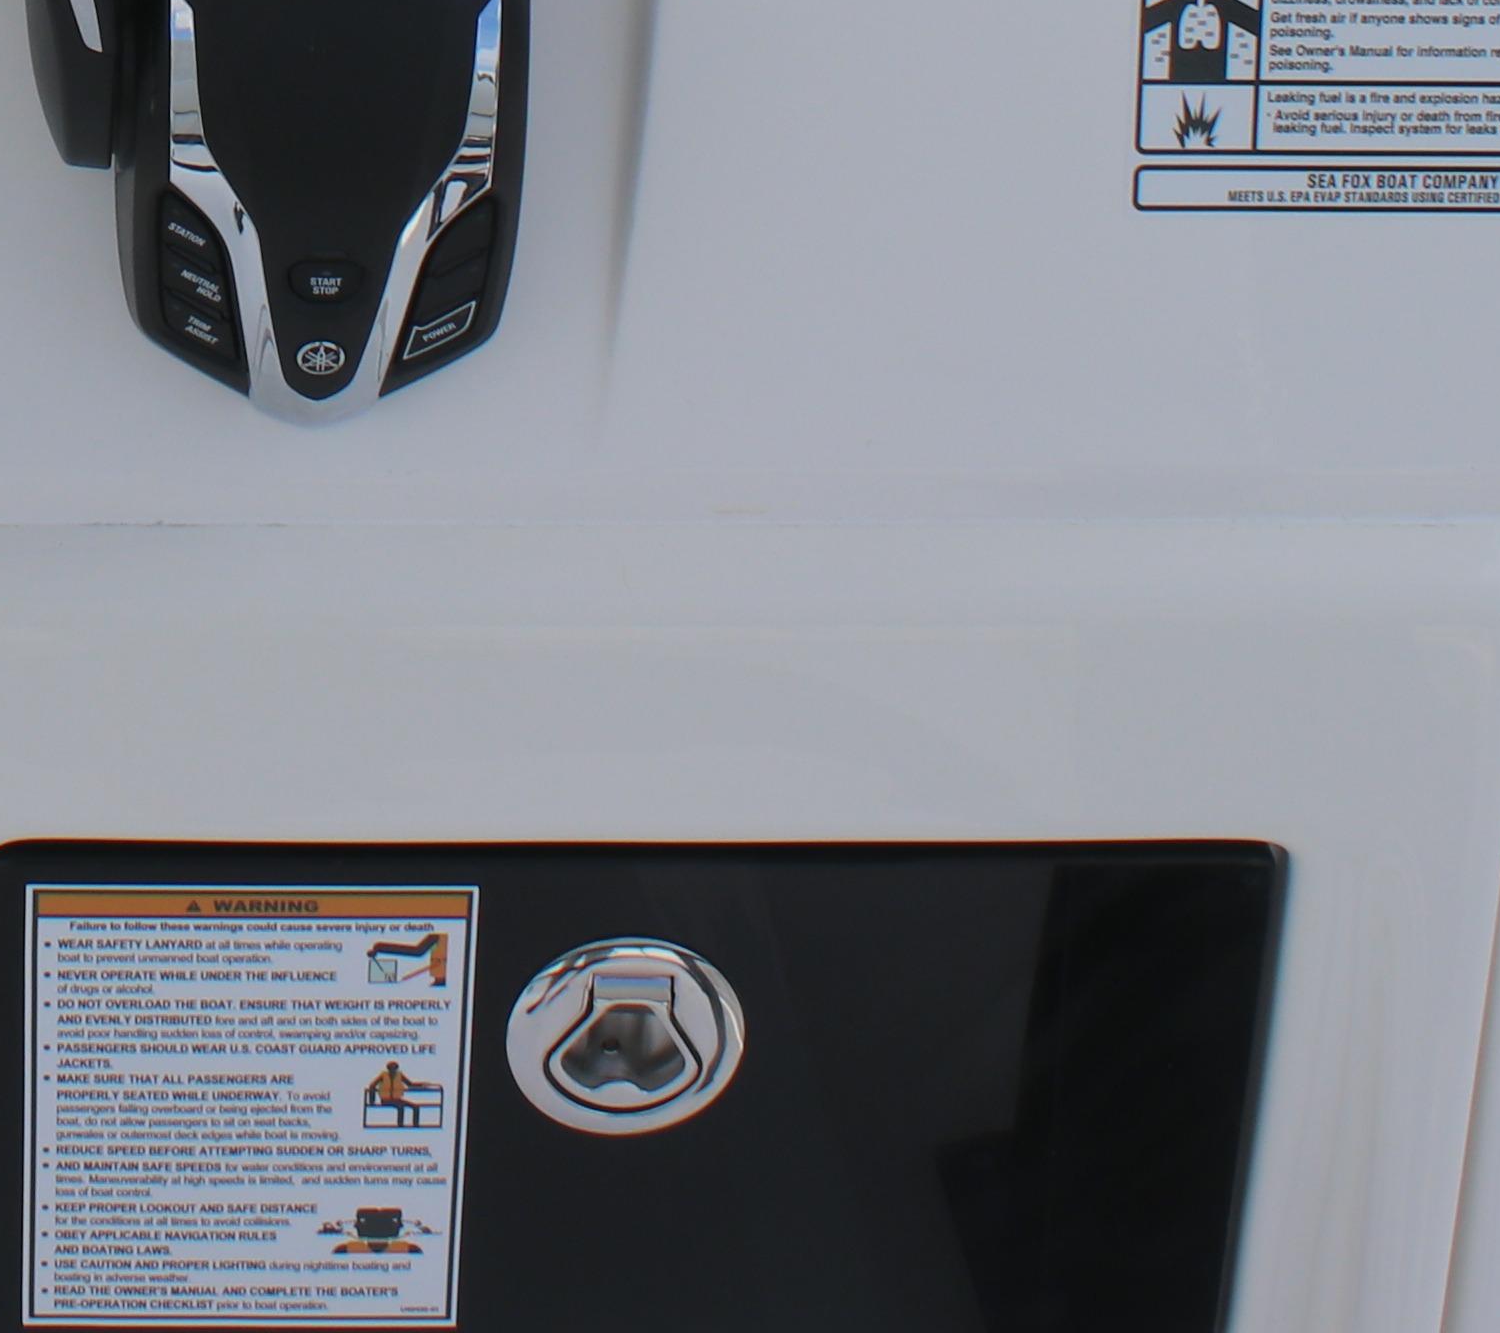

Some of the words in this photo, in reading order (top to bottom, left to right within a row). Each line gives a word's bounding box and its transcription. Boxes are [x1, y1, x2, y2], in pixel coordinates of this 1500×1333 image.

[1307, 173, 1337, 189] SEA
[1341, 173, 1372, 189] FOX
[1376, 174, 1417, 190] BOAT
[1422, 174, 1498, 190] COMPANY
[1227, 190, 1265, 203] MEETS
[1266, 190, 1288, 203] U.S.
[1289, 190, 1311, 203] EPA
[1313, 190, 1342, 204] EVAP
[1343, 191, 1410, 204] STANDARDS
[1410, 191, 1445, 204] USING
[1446, 191, 1500, 204] CERTIFIED
[167, 222, 207, 247] STATION
[181, 269, 220, 293] NEUTRAL
[310, 277, 342, 287] START
[196, 286, 222, 303] HOLD
[312, 286, 339, 295] STOP
[422, 322, 457, 342] POWER
[213, 899, 319, 916] WARNING
[57, 970, 98, 981] NEVER
[100, 970, 156, 982] OPERATE
[159, 970, 197, 982] WHILE
[200, 970, 242, 982] UNDER
[245, 970, 267, 982] THE
[270, 971, 336, 982] INFLUENCE
[54, 1202, 86, 1213] KEEP
[88, 1202, 137, 1214] PROPER
[139, 1203, 196, 1214] LOOKOUT
[199, 1203, 224, 1214] AND
[226, 1203, 257, 1214] SAFE
[259, 1203, 317, 1214] DISTANCE
